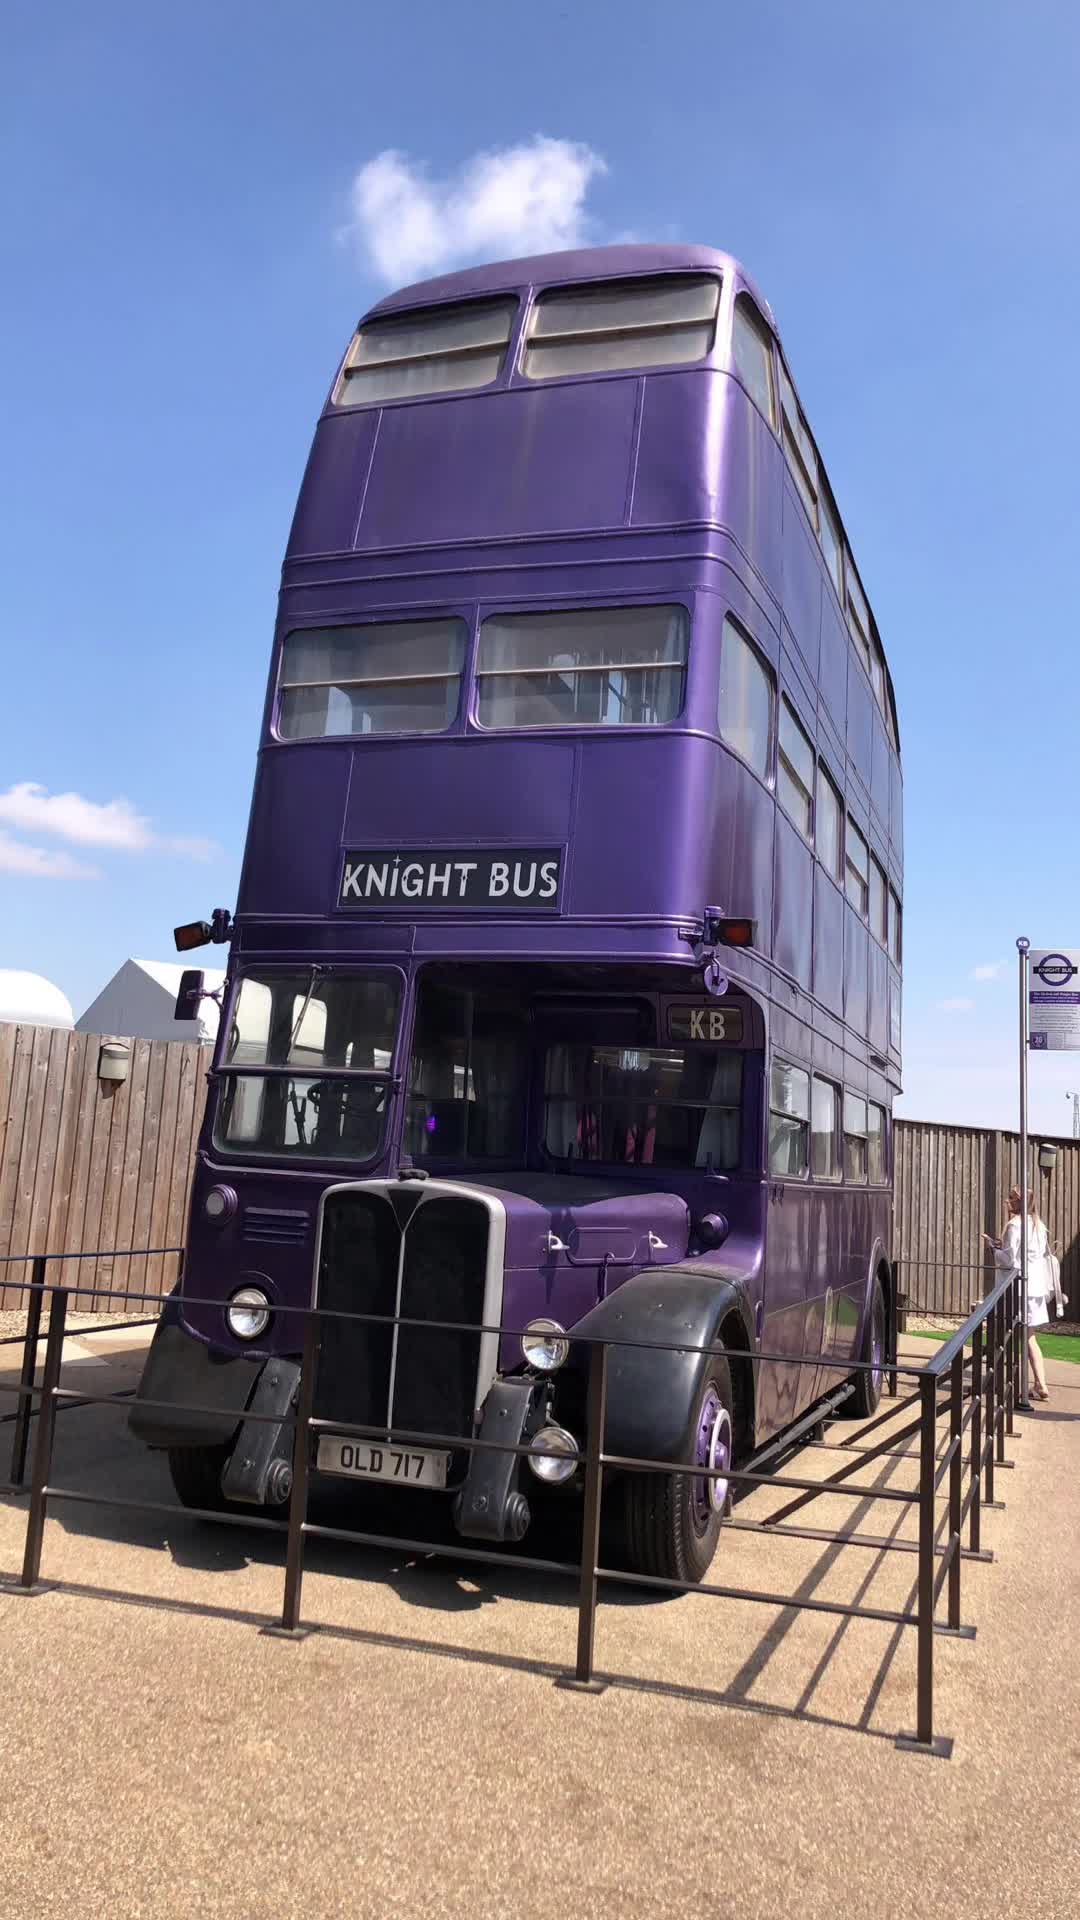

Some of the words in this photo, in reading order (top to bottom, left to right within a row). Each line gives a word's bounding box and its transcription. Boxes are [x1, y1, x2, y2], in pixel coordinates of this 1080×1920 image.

[488, 862, 558, 898] BUS
[690, 1010, 726, 1040] KB
[340, 1445, 384, 1473] OLD
[390, 1452, 425, 1479] 717
